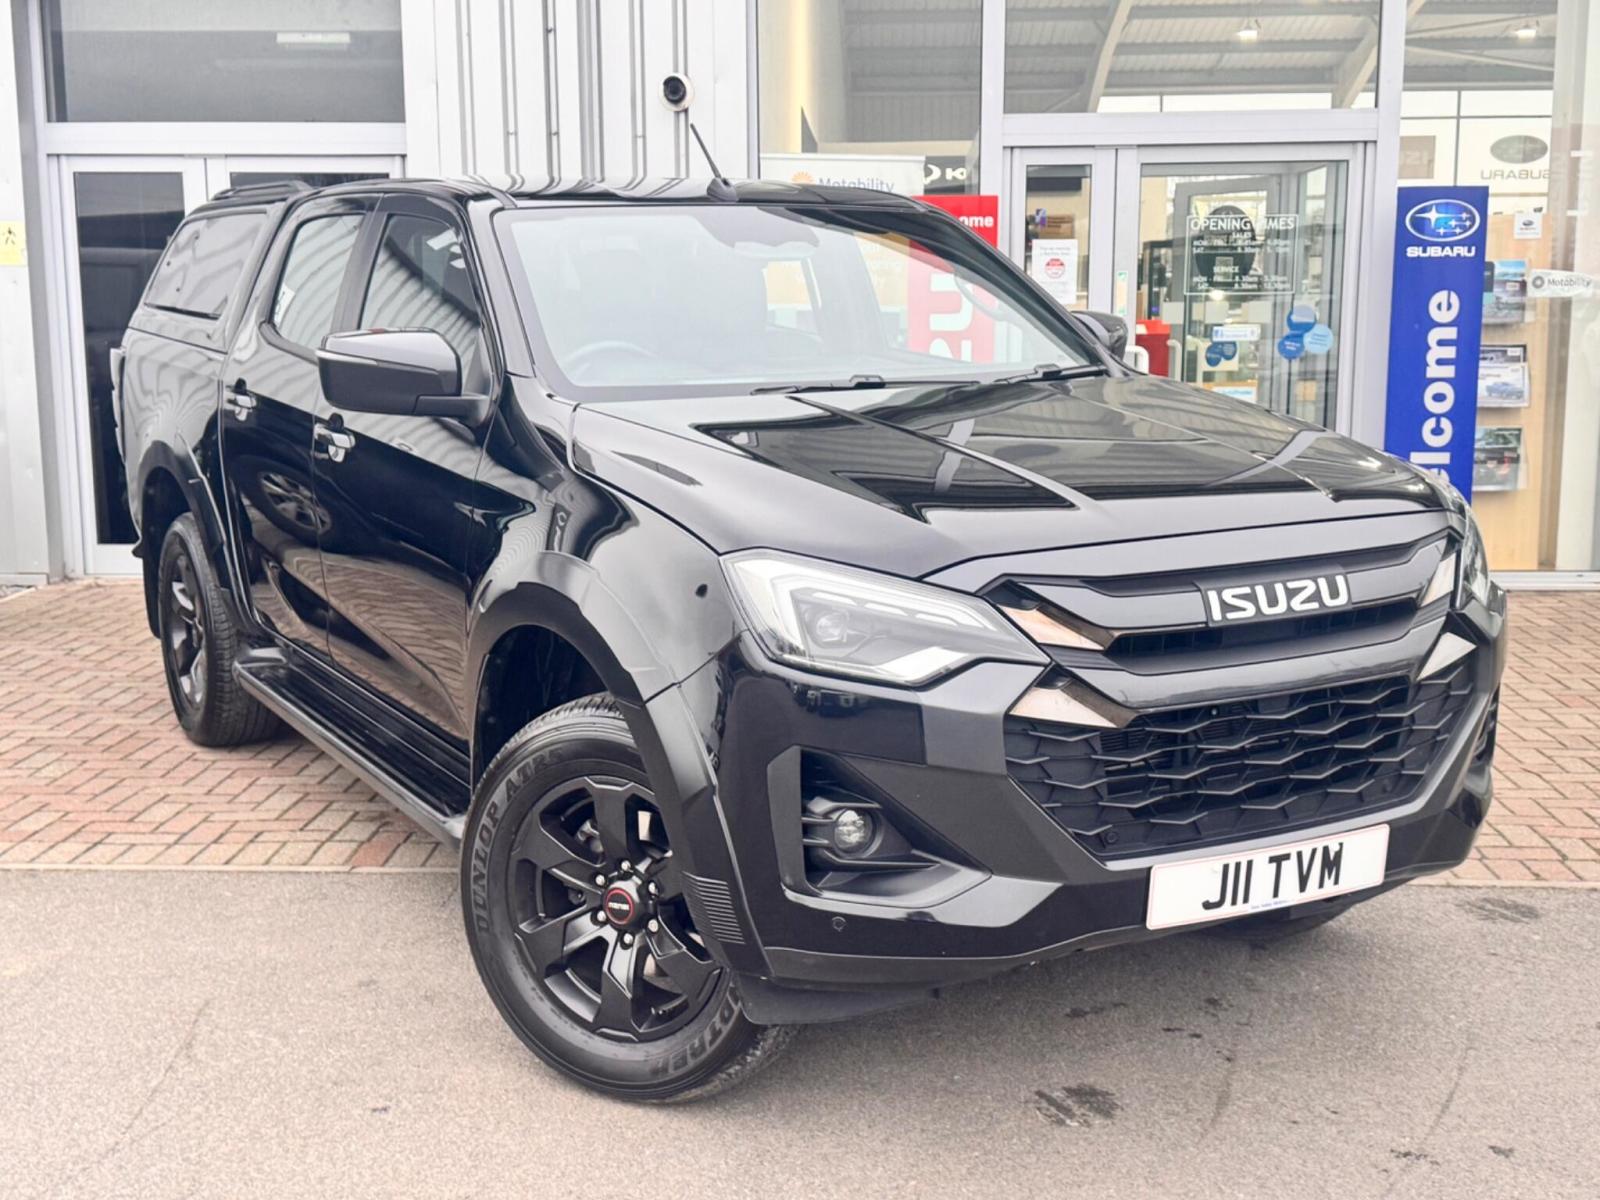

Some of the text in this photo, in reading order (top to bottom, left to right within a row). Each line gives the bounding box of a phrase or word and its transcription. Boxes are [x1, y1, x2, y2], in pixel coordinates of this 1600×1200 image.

[1190, 217, 1252, 230] OPENING
[1406, 245, 1475, 258] SUBARU
[1206, 574, 1350, 622] ISUZU
[470, 800, 498, 935] DUNLOP
[1201, 841, 1345, 911] J11 TVM
